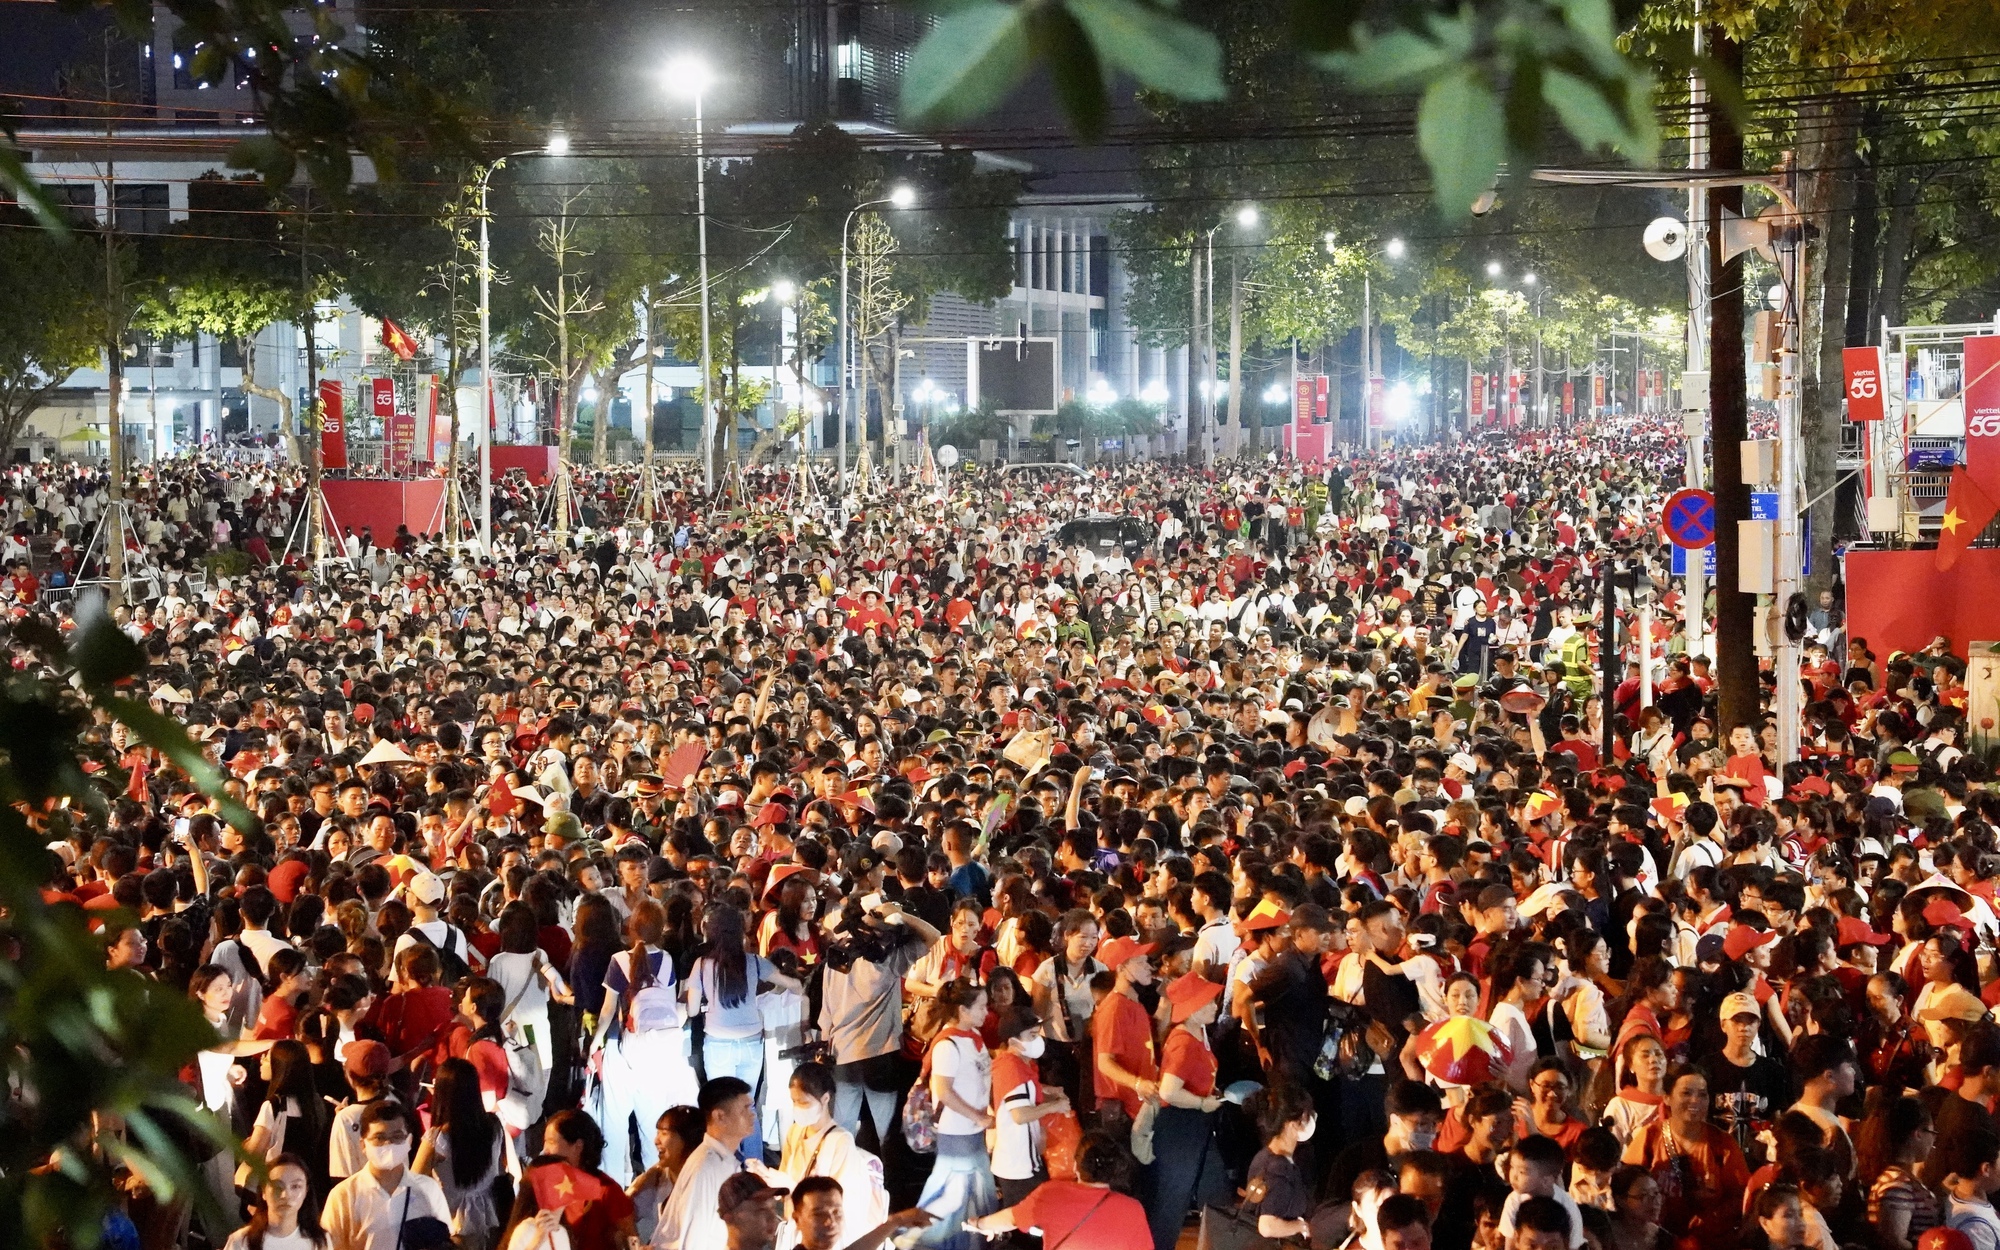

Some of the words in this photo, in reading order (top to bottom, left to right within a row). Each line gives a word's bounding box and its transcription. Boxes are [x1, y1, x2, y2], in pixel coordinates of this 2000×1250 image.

[1850, 377, 1877, 399] 5G
[376, 394, 392, 405] 5G
[324, 421, 340, 433] 5G
[1968, 415, 2000, 437] 5G
